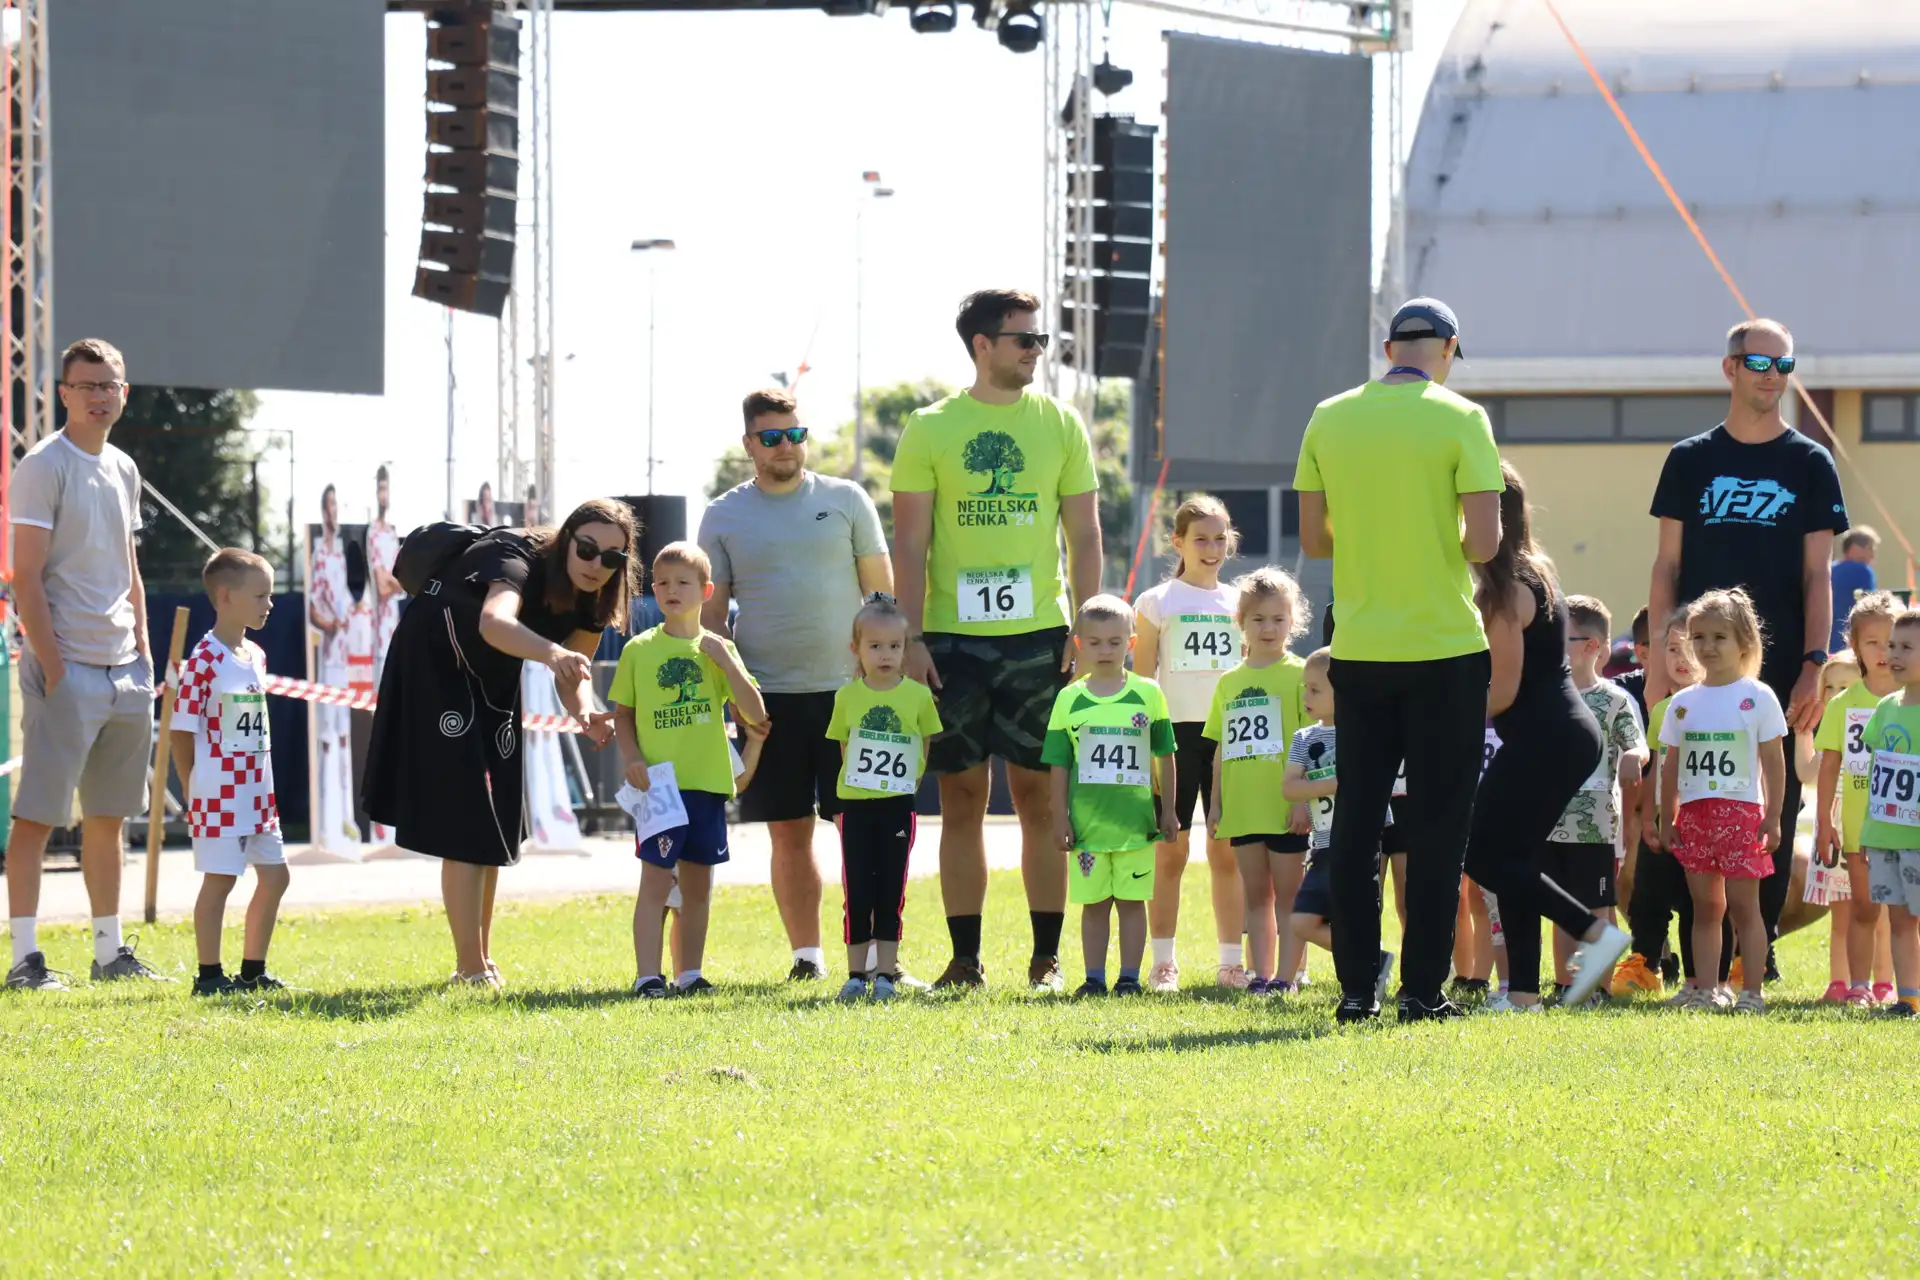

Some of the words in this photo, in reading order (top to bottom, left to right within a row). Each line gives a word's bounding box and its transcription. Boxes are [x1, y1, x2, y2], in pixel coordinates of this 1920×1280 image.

[957, 500, 1038, 513] NEDELSKA
[957, 513, 1008, 527] CENKA
[966, 571, 1004, 579] NEDELSKA
[977, 585, 1015, 612] 16
[1184, 631, 1232, 656] 443
[653, 703, 712, 719] NEDELSKA
[654, 715, 693, 730] CENKA
[1228, 714, 1270, 745] 528
[1847, 723, 1872, 754] 3
[857, 747, 907, 779] 526
[1090, 743, 1140, 770] 441
[1685, 750, 1736, 777] 446
[1898, 805, 1920, 820] tre
